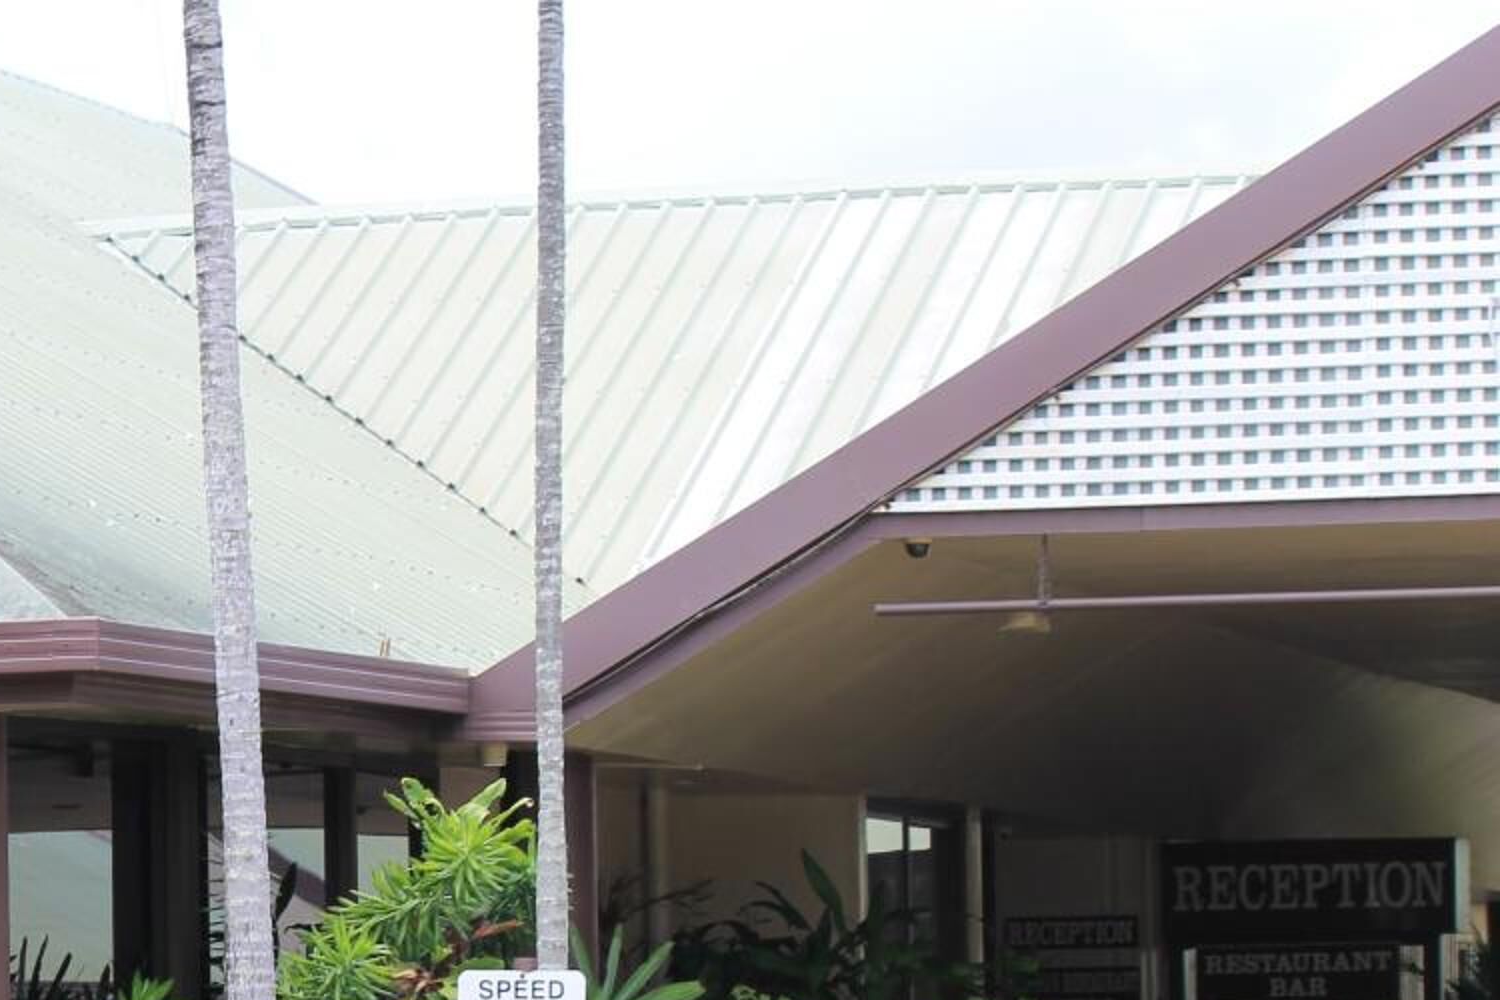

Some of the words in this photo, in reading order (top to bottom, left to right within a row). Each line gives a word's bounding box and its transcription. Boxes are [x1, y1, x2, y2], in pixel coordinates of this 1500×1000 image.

[1172, 862, 1445, 912] RECEPTION
[1009, 920, 1133, 945] RECEPTION
[1203, 951, 1391, 975] RESTAURANT
[479, 980, 565, 1000] SPEED
[1269, 977, 1328, 998] BAR
